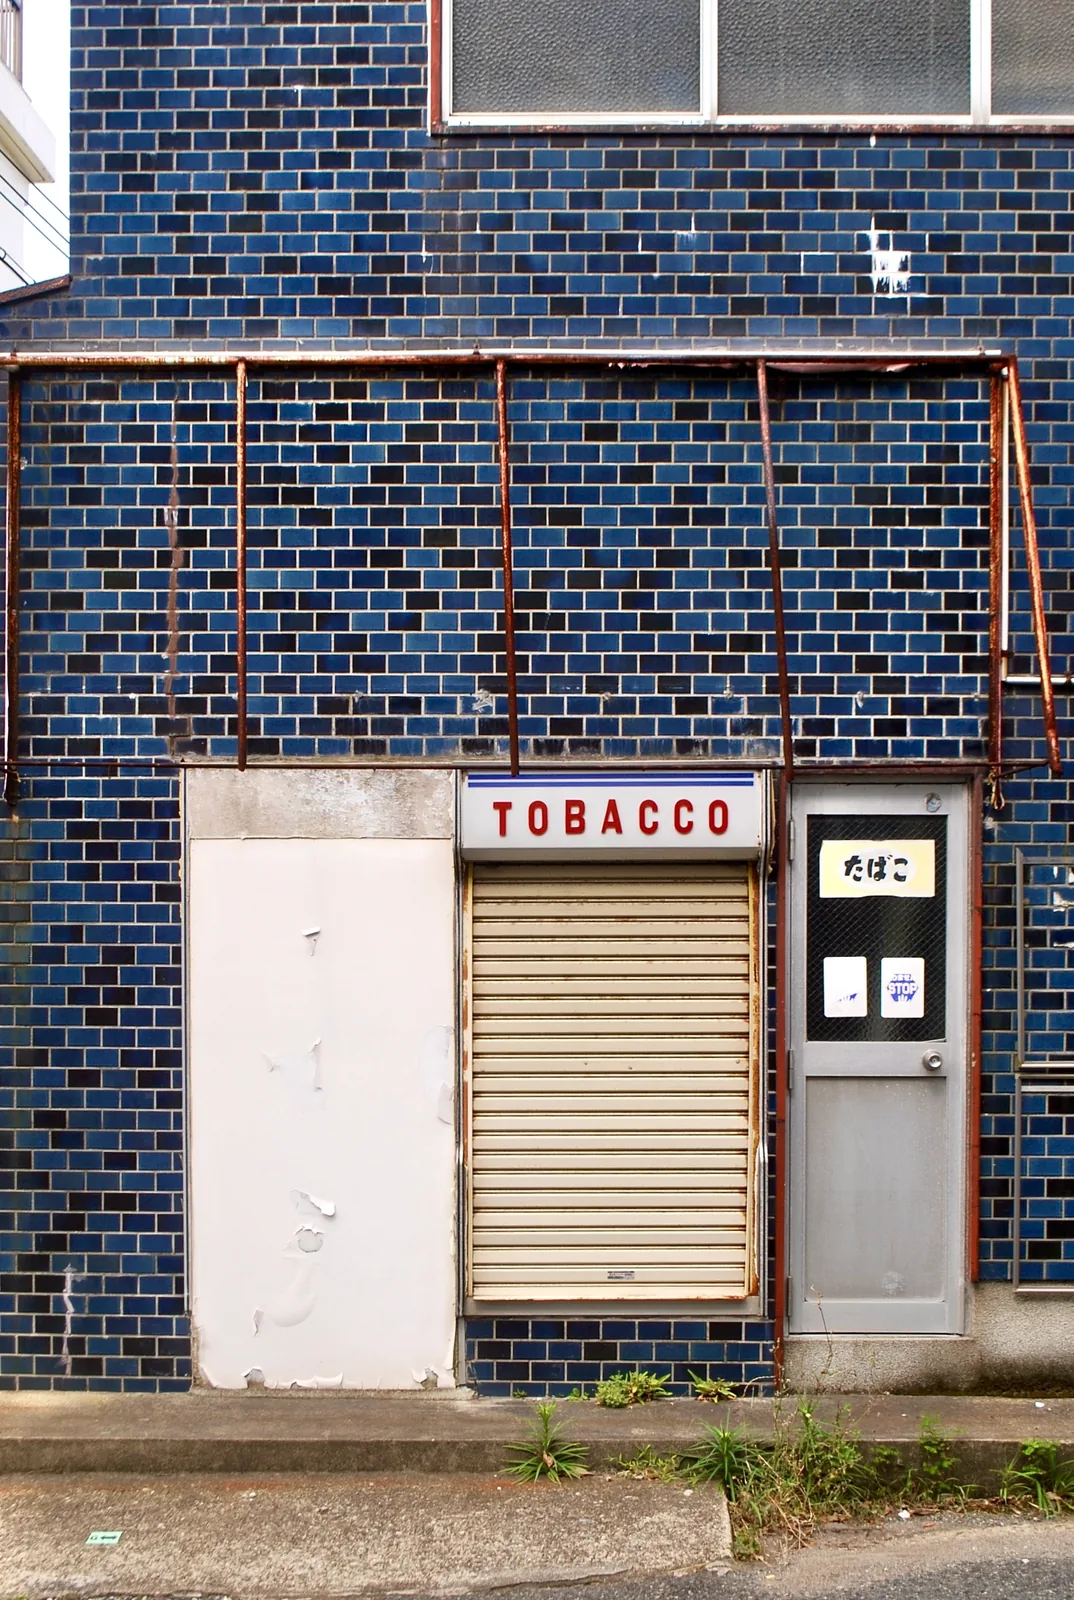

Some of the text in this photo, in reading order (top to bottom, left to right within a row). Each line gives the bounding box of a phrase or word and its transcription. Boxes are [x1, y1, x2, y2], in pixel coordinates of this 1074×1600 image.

[492, 799, 729, 837] TOBACCO
[844, 854, 909, 882] たばこ
[888, 982, 917, 995] STOP
